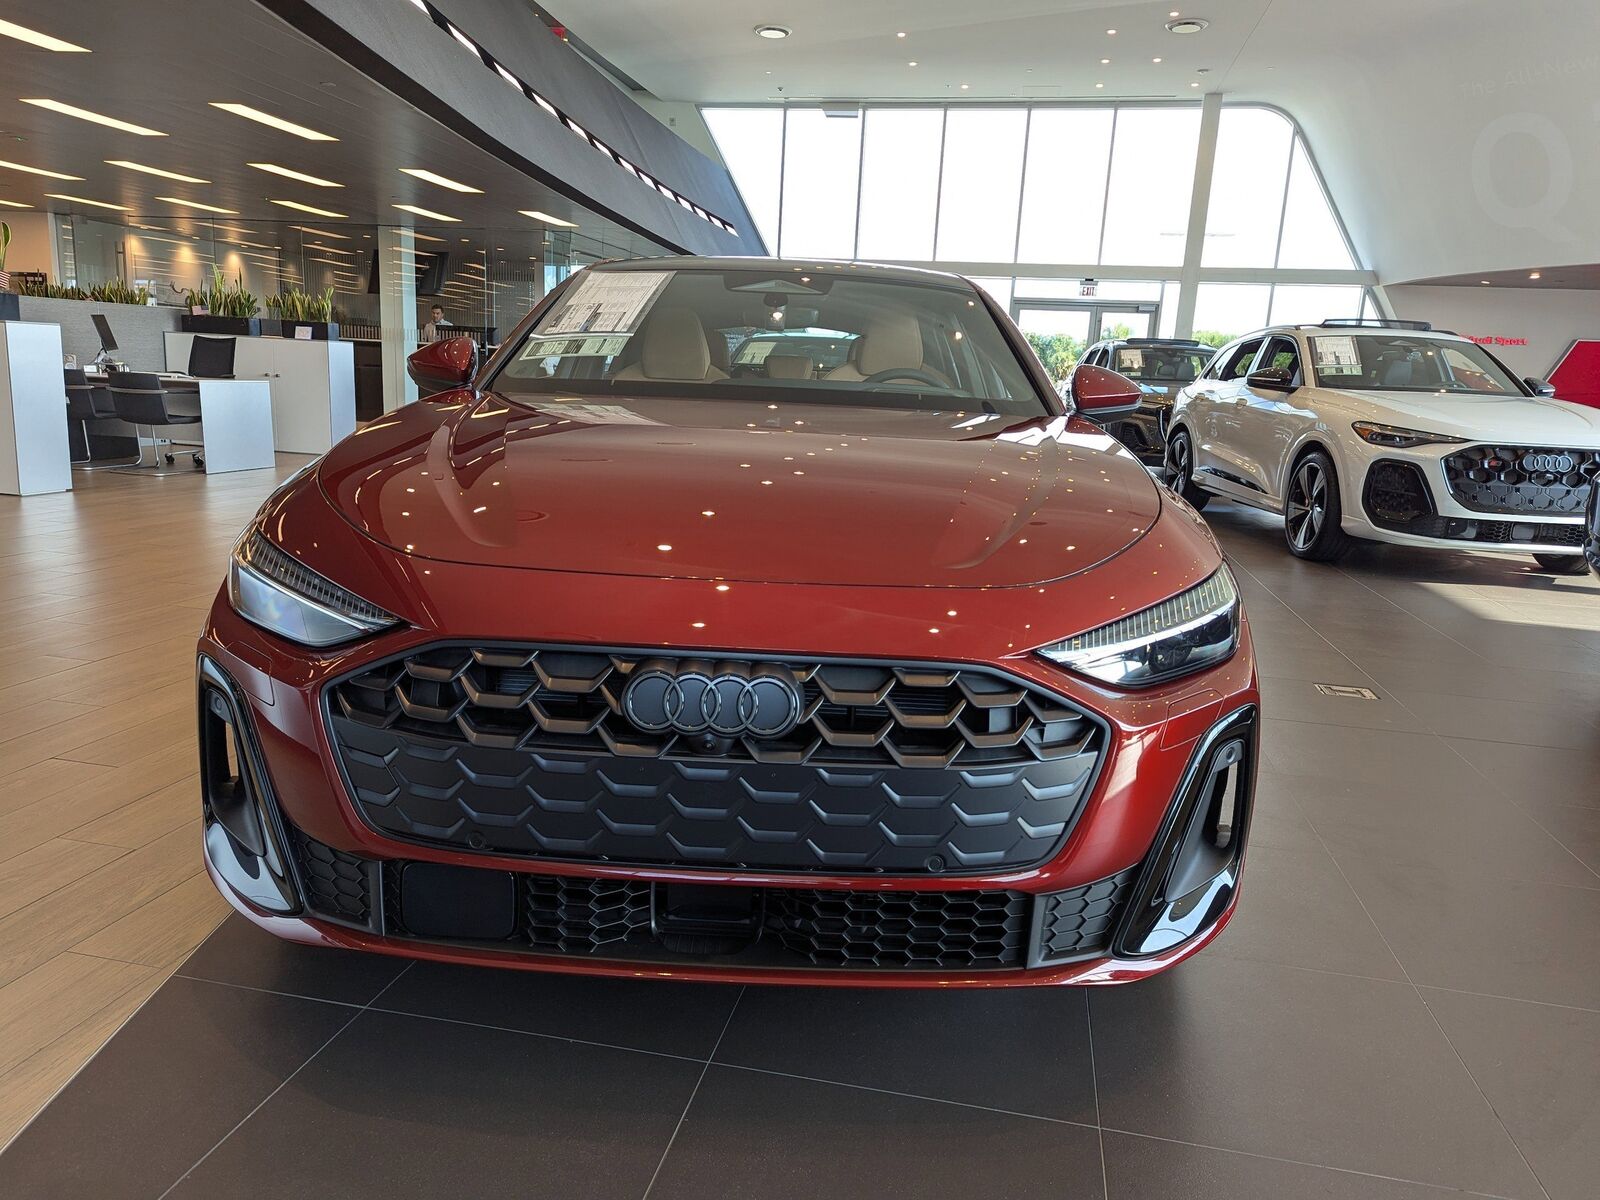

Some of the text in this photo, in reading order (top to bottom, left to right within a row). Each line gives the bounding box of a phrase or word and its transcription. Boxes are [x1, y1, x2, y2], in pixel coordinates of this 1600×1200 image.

[1457, 79, 1497, 100] The
[1081, 286, 1096, 296] EXIT
[1495, 336, 1528, 346] Sport
